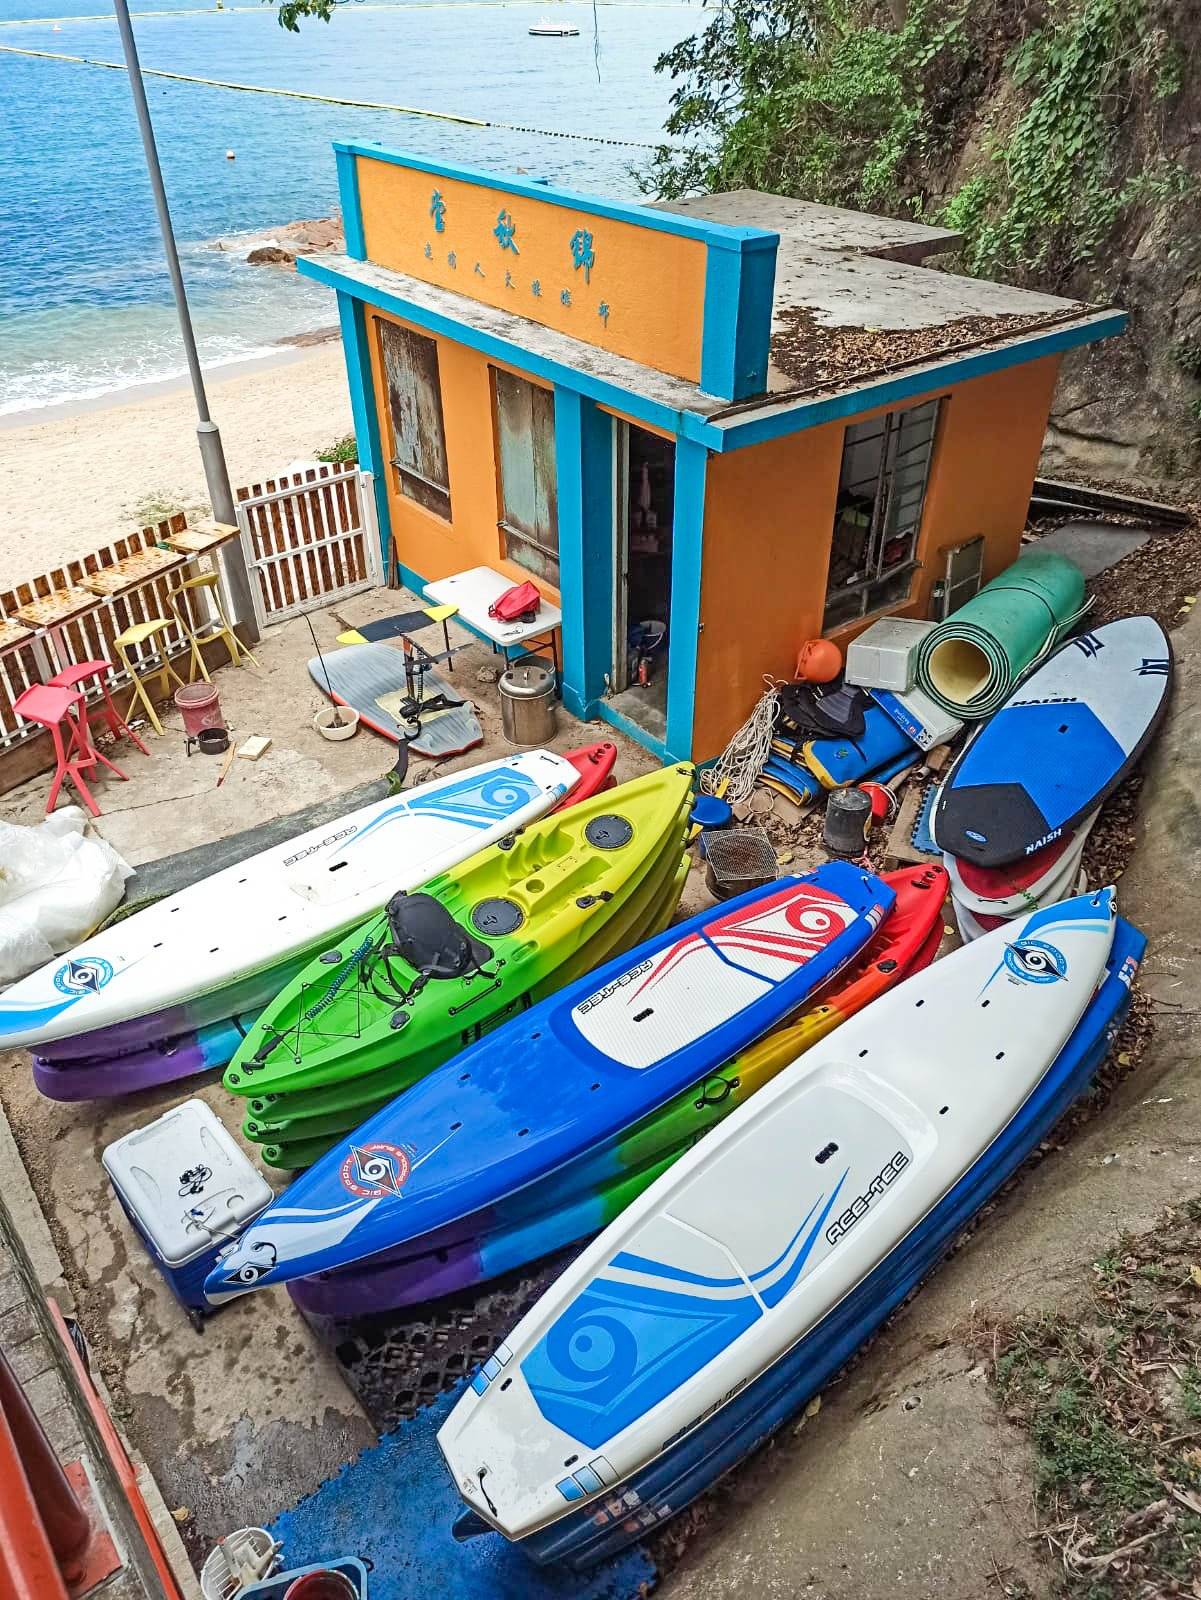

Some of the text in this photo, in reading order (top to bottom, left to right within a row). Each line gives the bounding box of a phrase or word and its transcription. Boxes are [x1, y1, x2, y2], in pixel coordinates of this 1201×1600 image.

[1025, 828, 1063, 855] NAISH
[577, 959, 654, 1015] ACE-TEC
[341, 1157, 382, 1196] BIC SPORT
[825, 1150, 910, 1245] ACE-TEC
